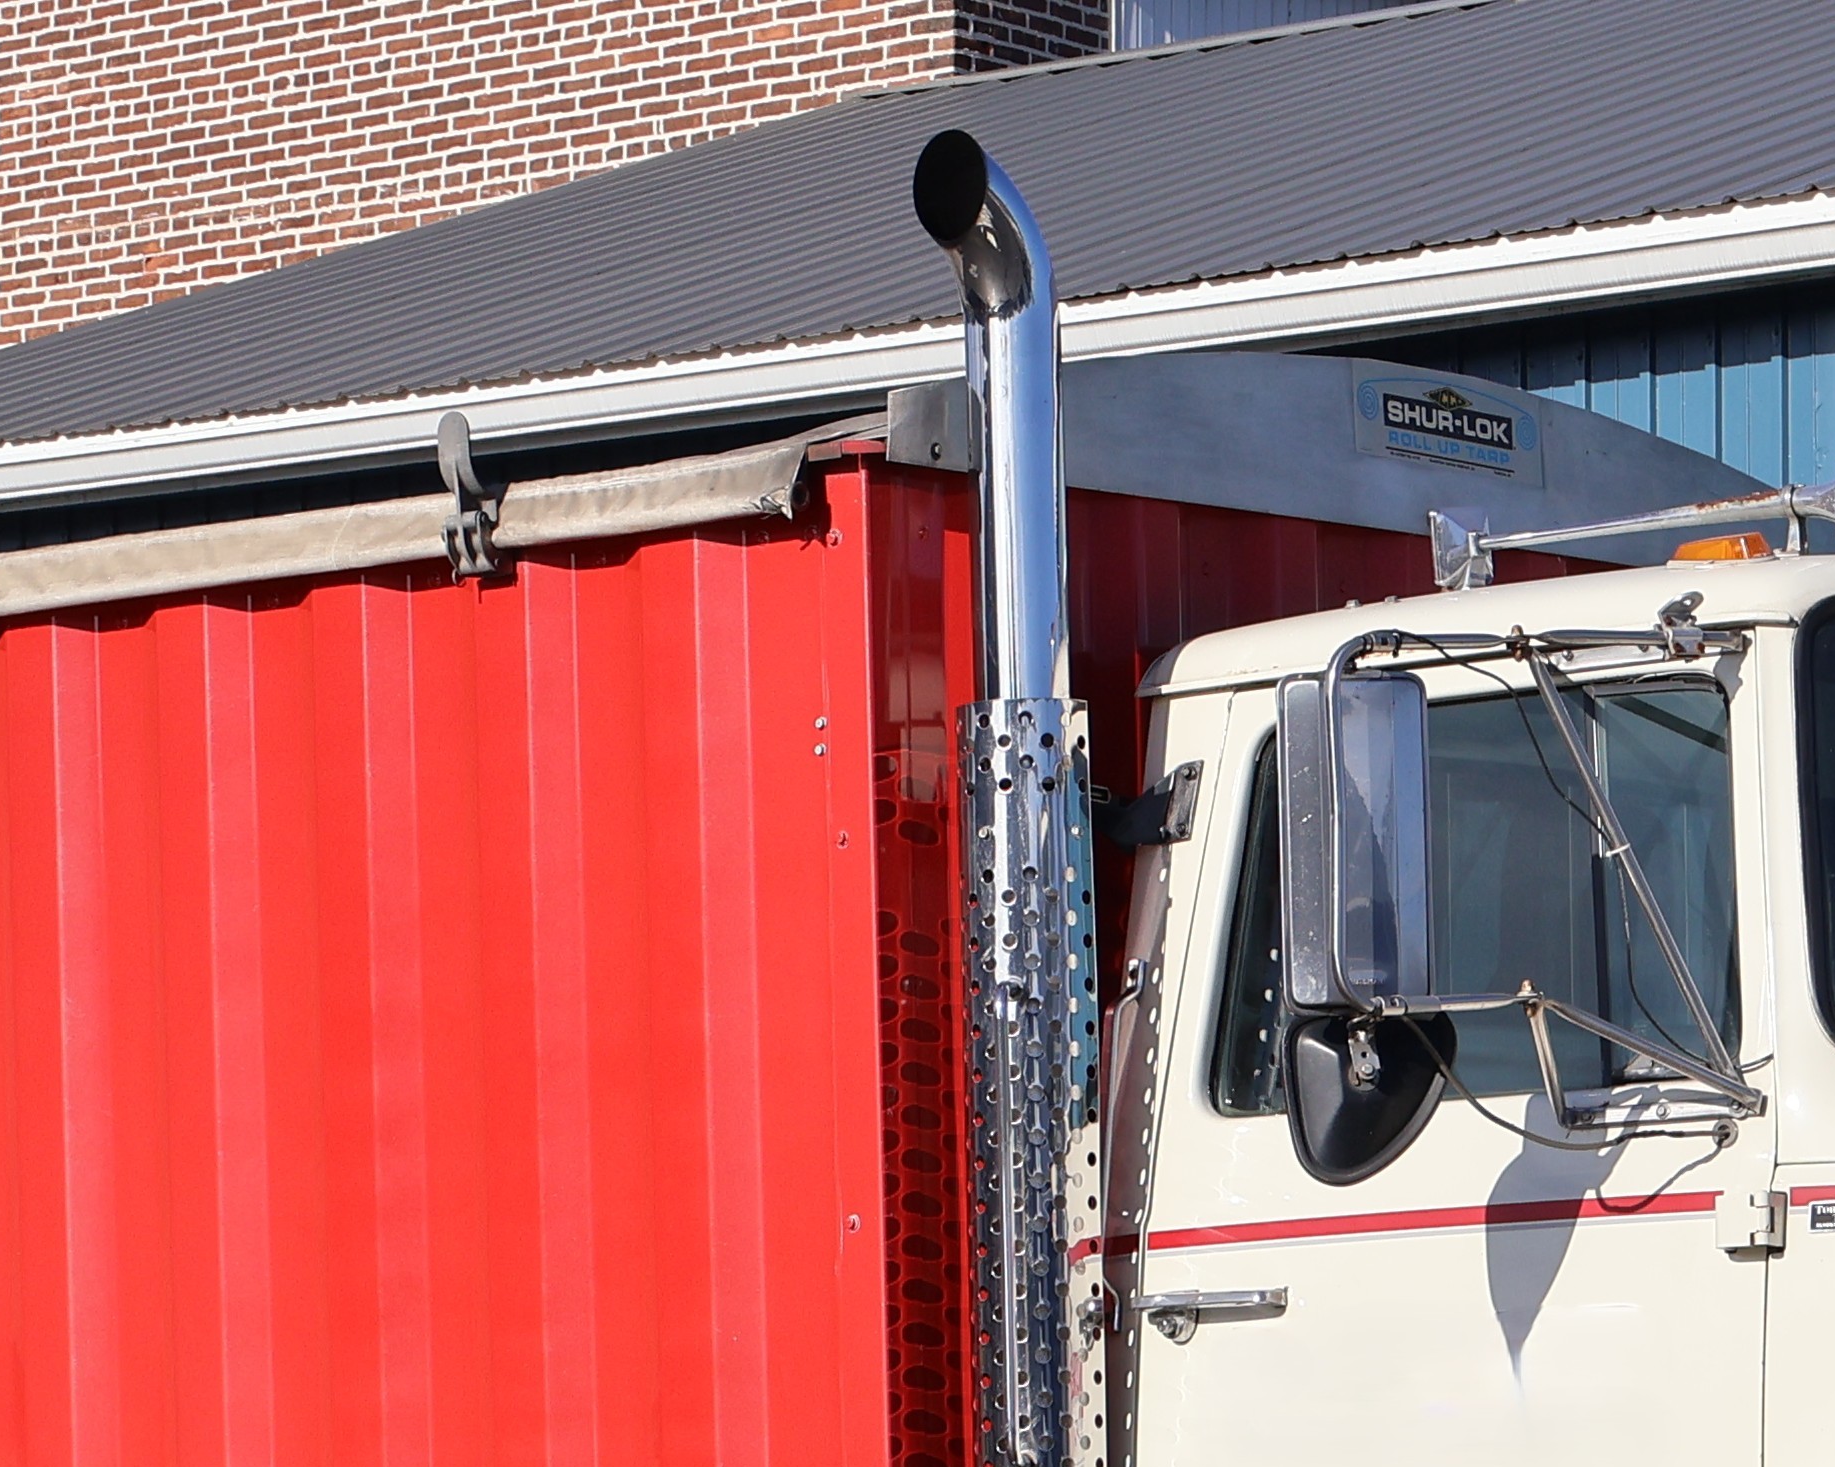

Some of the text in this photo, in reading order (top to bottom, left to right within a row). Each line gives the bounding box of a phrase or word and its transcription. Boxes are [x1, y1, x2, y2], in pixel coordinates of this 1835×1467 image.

[1387, 400, 1510, 444] SHUR-LOK
[1388, 430, 1510, 464] ROLL UP TARP
